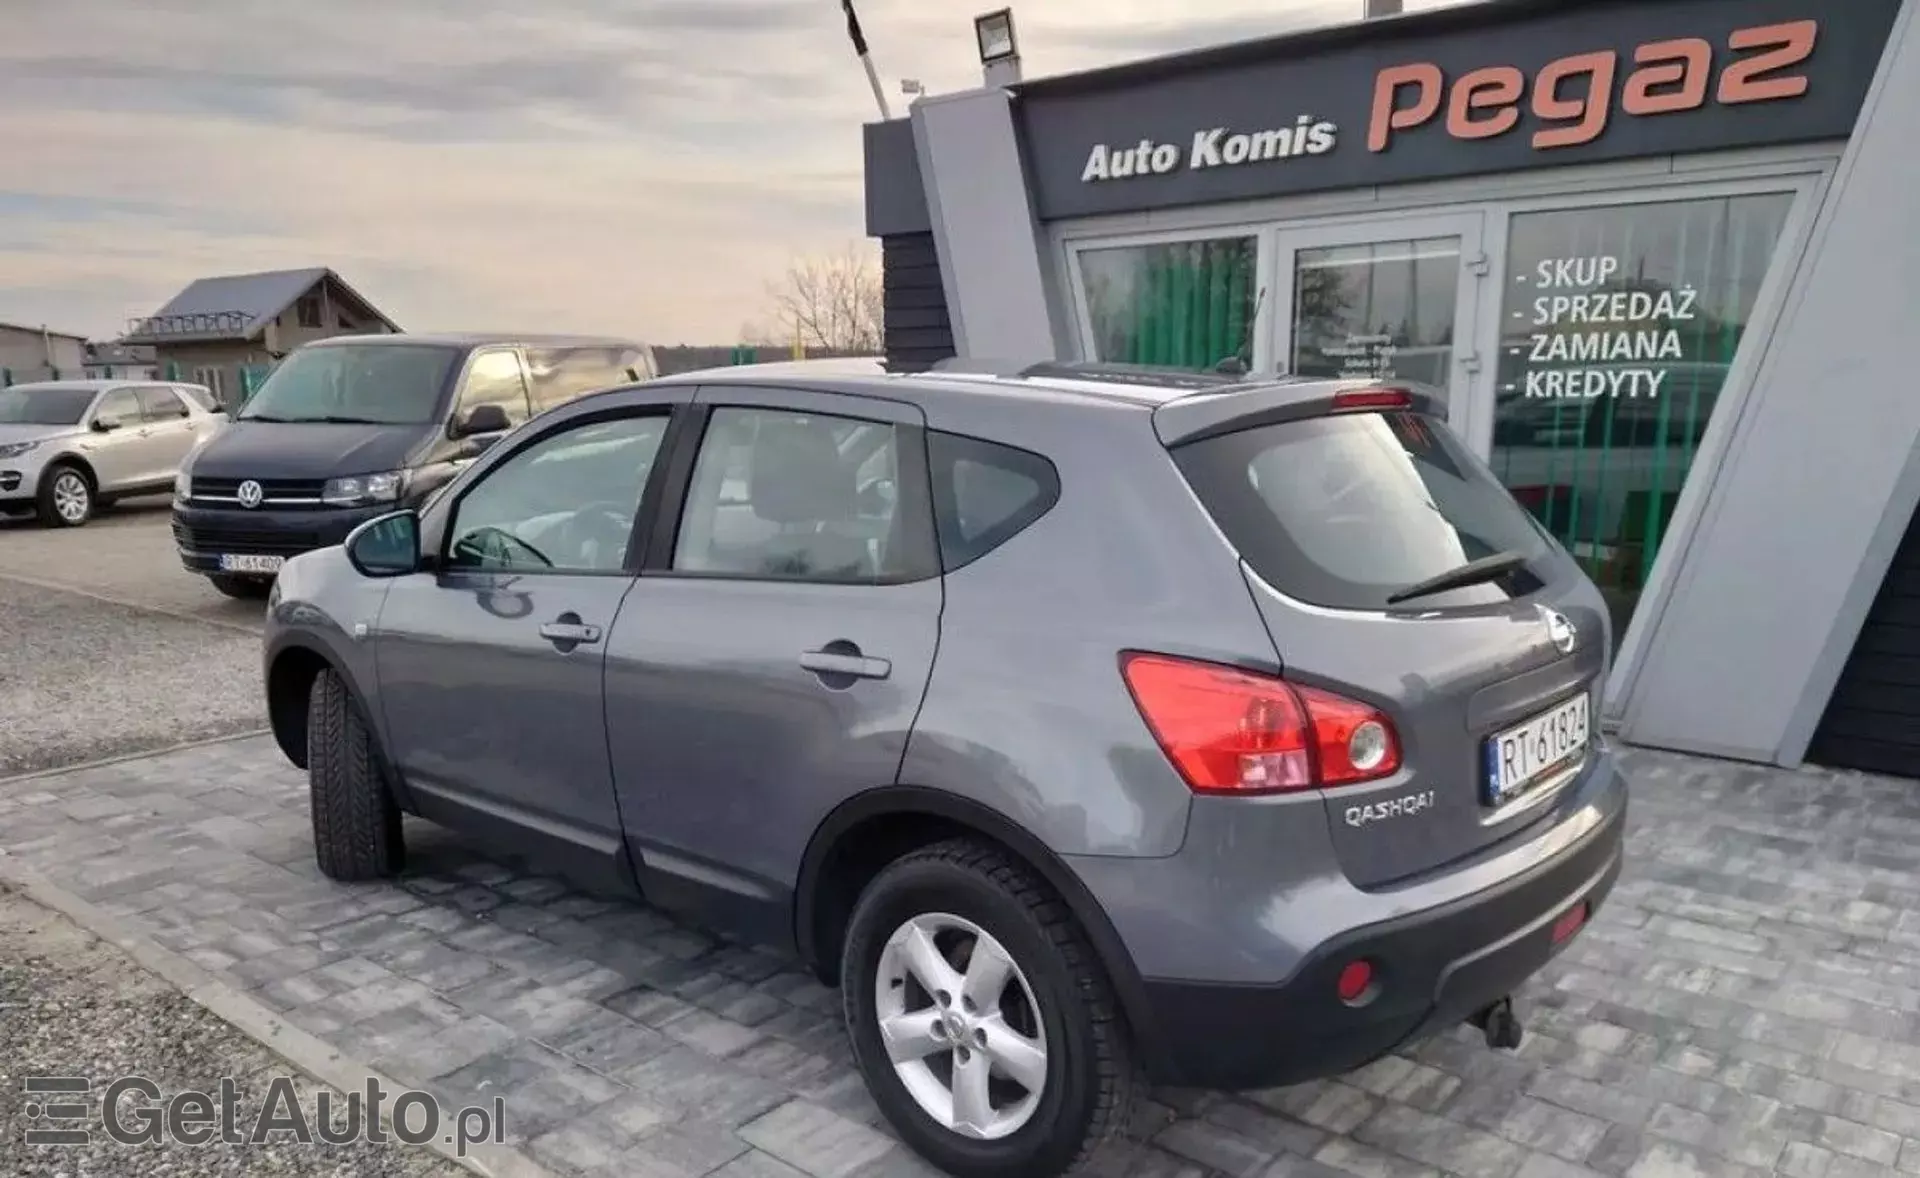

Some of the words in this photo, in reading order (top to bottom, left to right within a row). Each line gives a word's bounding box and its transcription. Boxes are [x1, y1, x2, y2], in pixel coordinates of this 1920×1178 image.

[1081, 139, 1180, 182] Auto
[1190, 115, 1338, 170] Komis
[1536, 256, 1618, 289] SKUP
[1533, 283, 1698, 326] SPRZEDAŻ
[1528, 329, 1683, 362] ZAMIANA
[1525, 369, 1666, 398] KREDYTY
[1503, 730, 1528, 785] RT
[1537, 698, 1586, 763] 61824
[1345, 790, 1435, 827] QASHQAI
